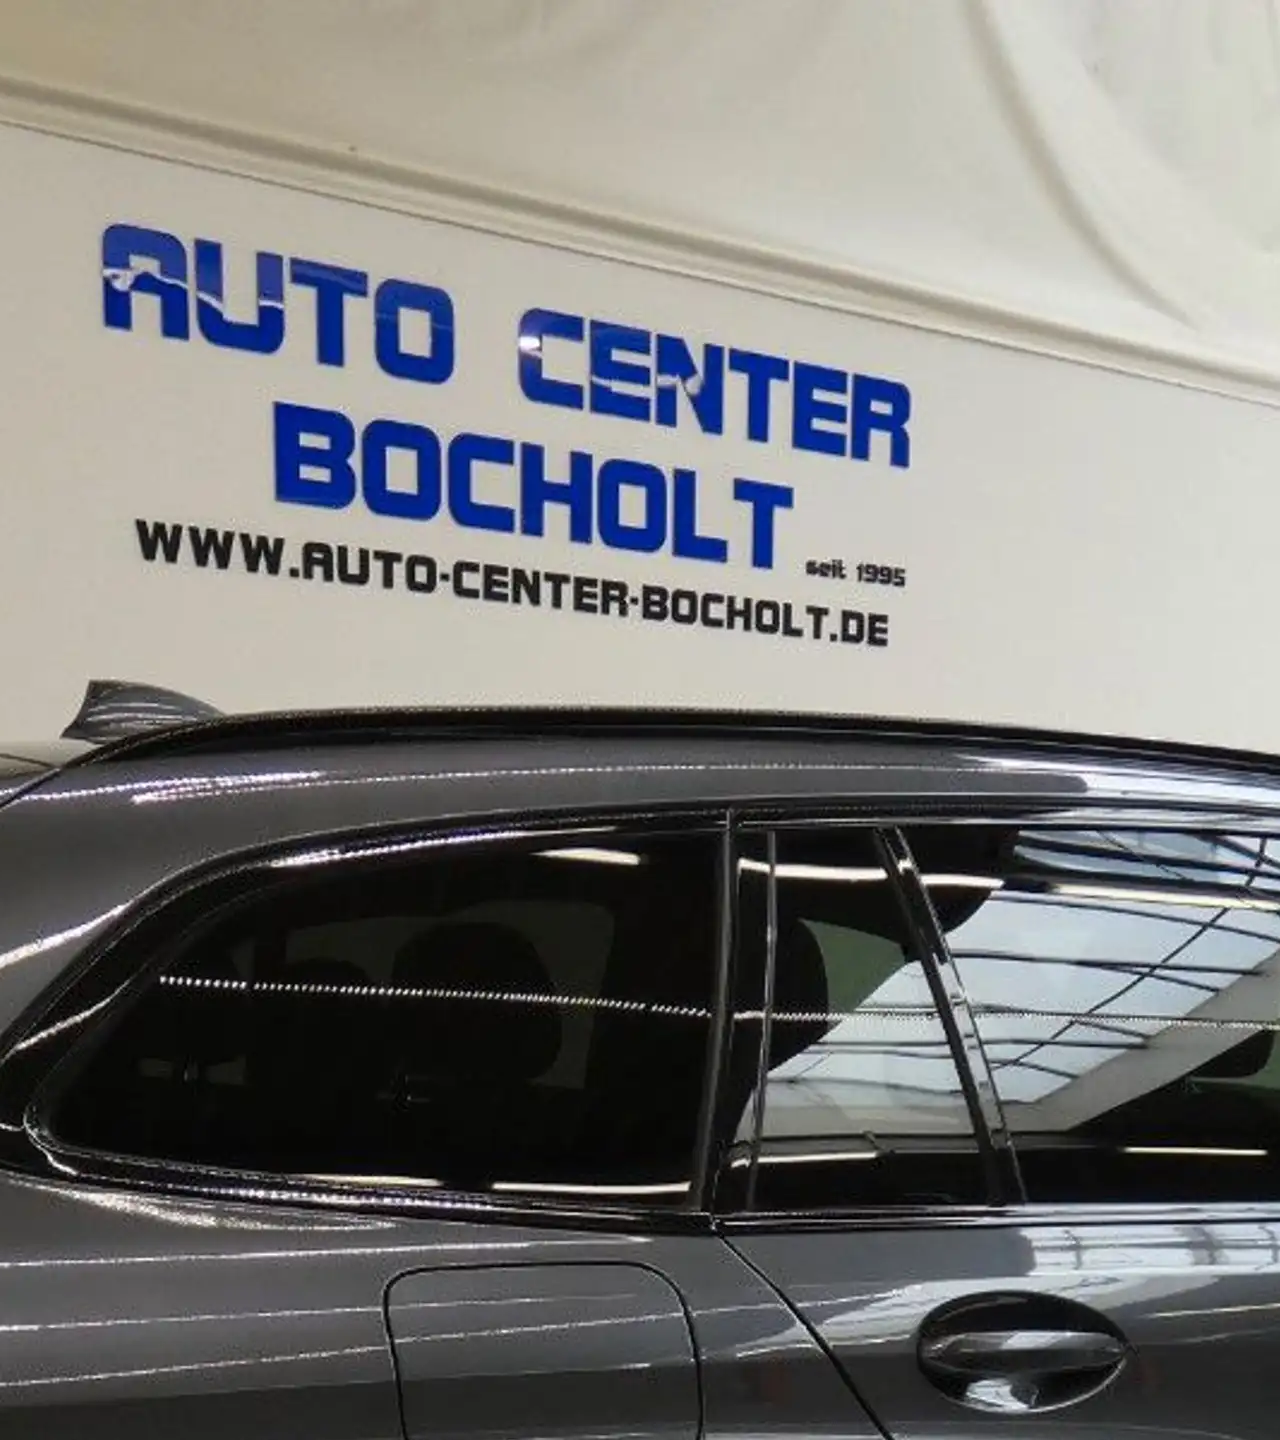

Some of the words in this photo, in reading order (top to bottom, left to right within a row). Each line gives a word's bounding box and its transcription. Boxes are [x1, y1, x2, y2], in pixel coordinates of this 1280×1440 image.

[102, 222, 456, 386] AUTO
[519, 307, 913, 470] CENTER
[272, 400, 795, 571] BOCHOLT
[134, 517, 890, 648] WWW.AUTO-CENTER-BOCHOLT.DE
[805, 559, 847, 580] seit
[856, 563, 907, 588] 1995
